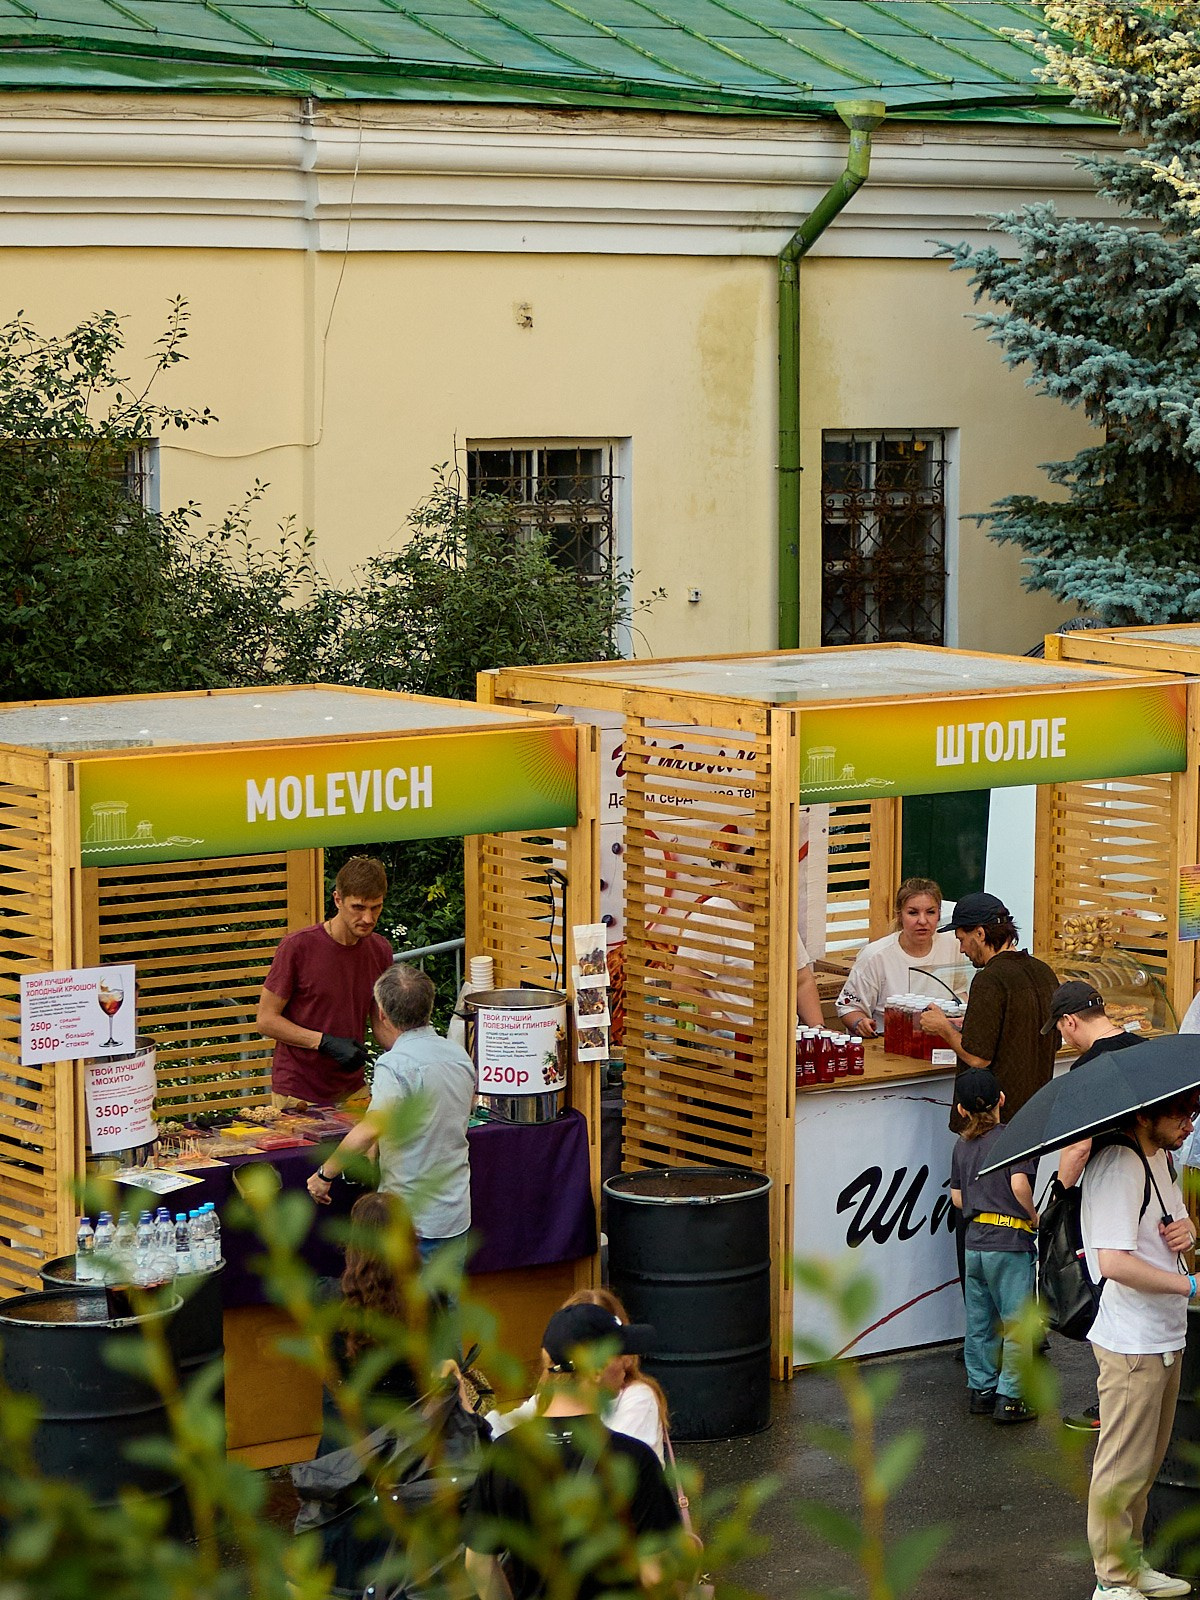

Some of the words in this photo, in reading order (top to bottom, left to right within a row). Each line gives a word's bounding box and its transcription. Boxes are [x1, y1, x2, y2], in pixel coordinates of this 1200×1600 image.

[936, 717, 1067, 766] ШТОЛЛЕ
[246, 765, 433, 823] MOLEVICH
[26, 979, 43, 989] ТВОЙ
[44, 976, 73, 987] ЛУЧШИЙ
[26, 986, 63, 997] ХОЛОДНЫЙ
[65, 983, 97, 992] КРЮШОН
[483, 1013, 500, 1021] ТВОЙ
[501, 1013, 532, 1022] ЛУЧШИЙ
[30, 1021, 52, 1032] 250р
[483, 1021, 521, 1030] ПОЛЕЗНЫЙ
[522, 1019, 558, 1029] ГЛИНТВЕЙН
[90, 1066, 113, 1077] ТВОЙ
[115, 1060, 146, 1073] ЛУЧШИЙ
[91, 1074, 134, 1086] «МОХИТО»
[482, 1065, 530, 1087] 250р
[96, 1125, 122, 1137] 250р
